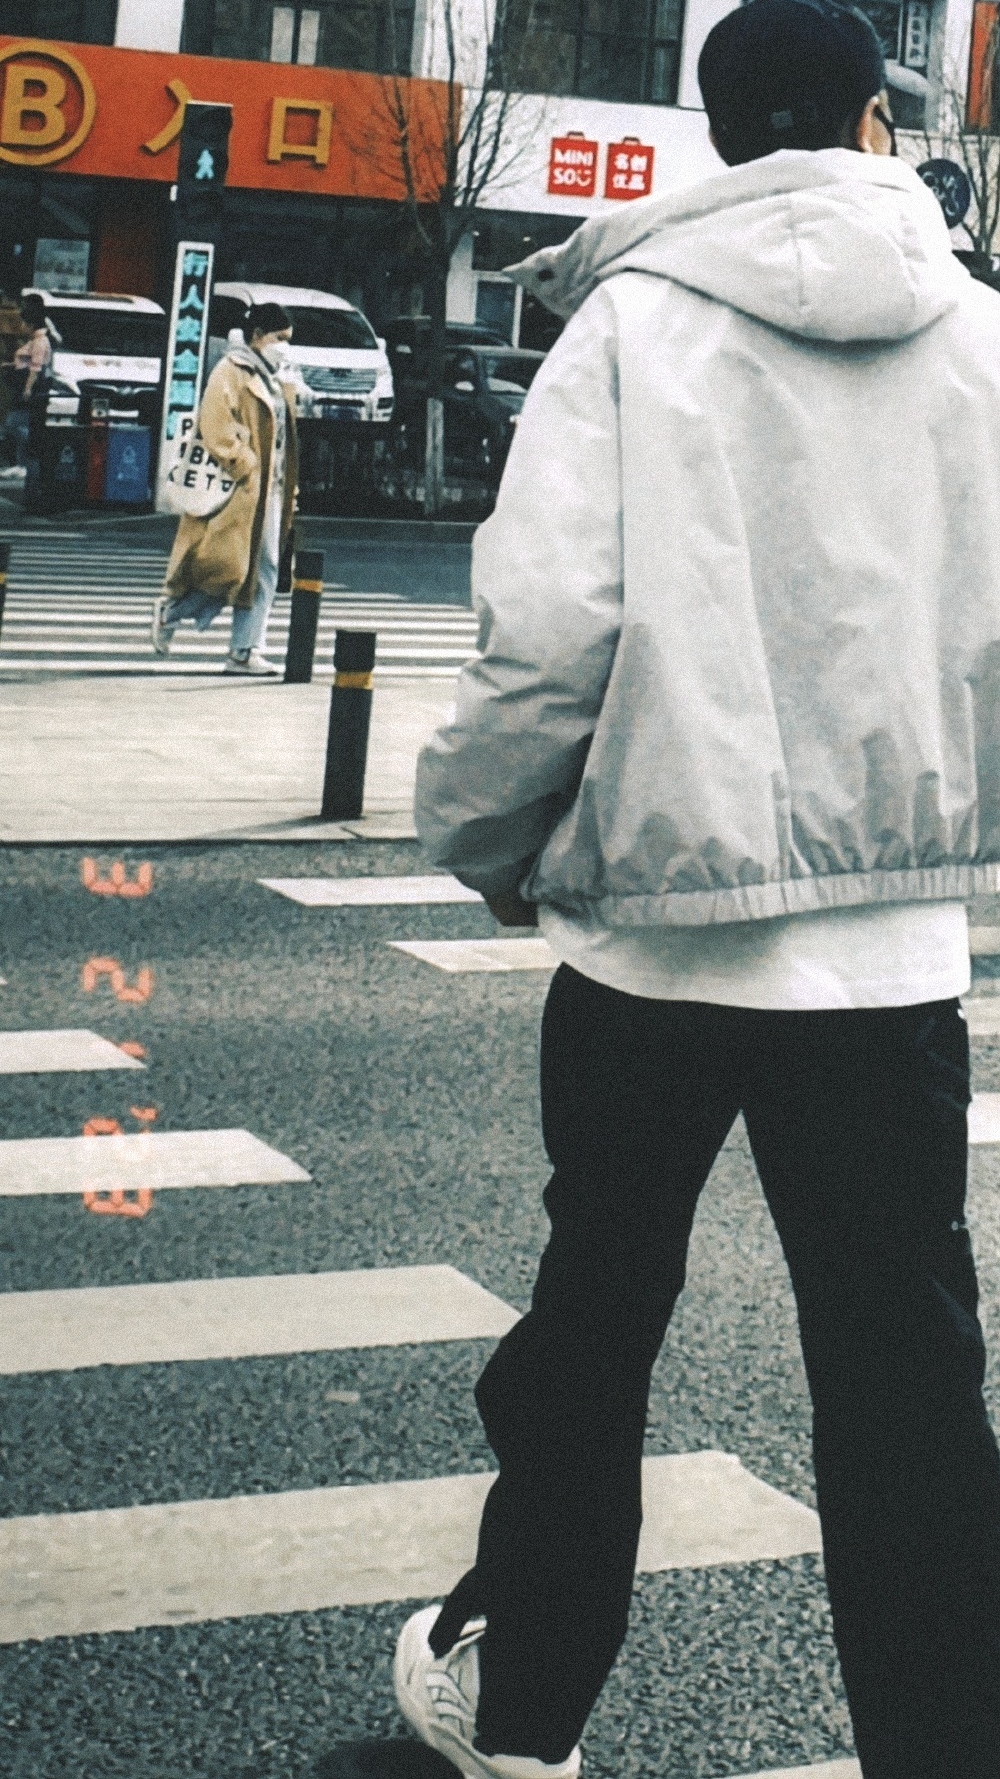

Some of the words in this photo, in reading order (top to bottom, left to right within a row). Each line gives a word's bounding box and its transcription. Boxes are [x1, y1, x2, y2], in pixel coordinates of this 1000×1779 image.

[554, 147, 594, 167] MINI
[613, 152, 648, 172] 名创
[612, 173, 646, 191] 优品
